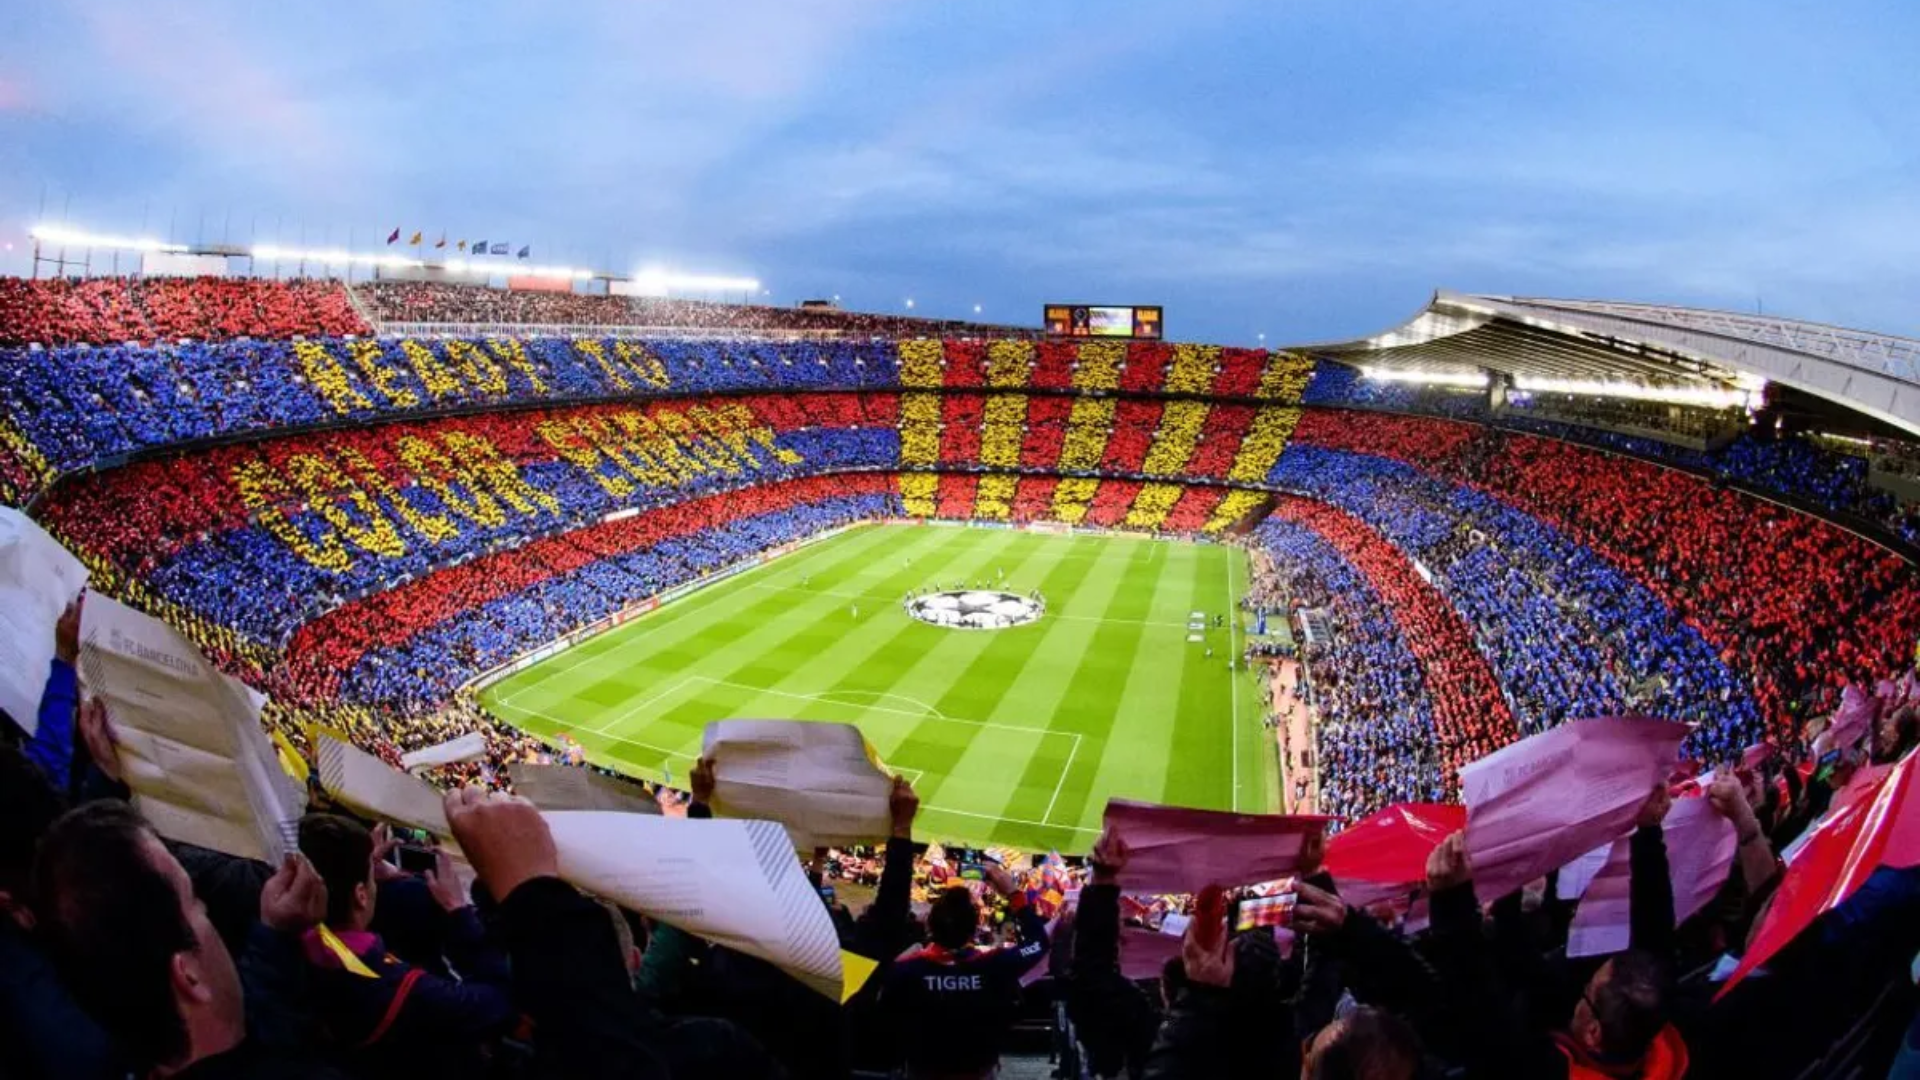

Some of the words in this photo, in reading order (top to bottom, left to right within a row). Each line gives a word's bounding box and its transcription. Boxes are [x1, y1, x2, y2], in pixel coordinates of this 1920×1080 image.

[294, 339, 548, 415] READY
[572, 338, 670, 391] TO
[231, 430, 561, 573] COLOR
[923, 975, 982, 991] TIGRE
